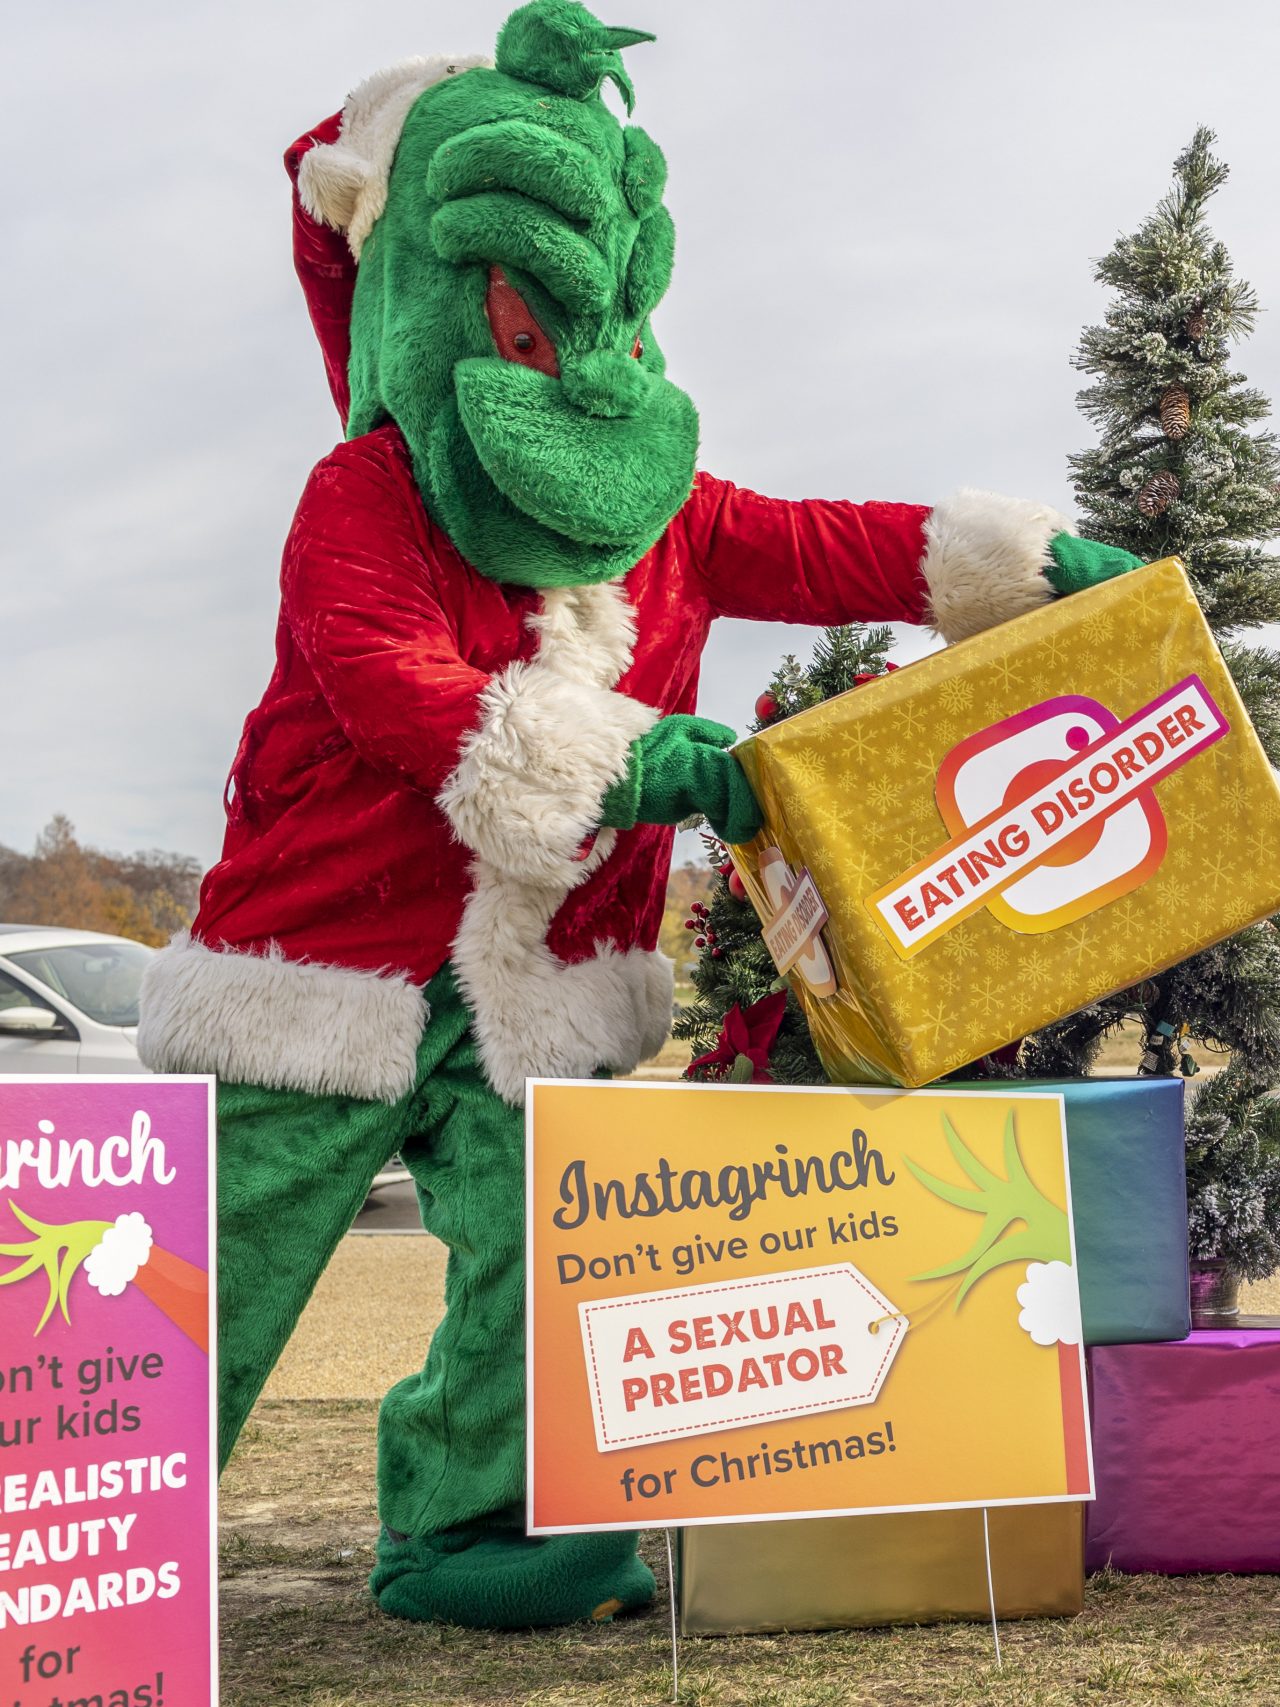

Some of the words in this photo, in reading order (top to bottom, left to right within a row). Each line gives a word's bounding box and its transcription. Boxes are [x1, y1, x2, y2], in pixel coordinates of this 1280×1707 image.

[894, 824, 1030, 931] EATING
[1032, 705, 1204, 834] DISORDER
[0, 1110, 176, 1190] rinch
[553, 1129, 895, 1229] Instagrinch
[557, 1244, 661, 1284] Don't
[673, 1235, 747, 1274] give
[760, 1227, 816, 1254] our
[828, 1211, 898, 1244] kids
[624, 1328, 654, 1362] A
[669, 1300, 834, 1353] SEXUAL
[0, 1355, 62, 1392] n't
[78, 1347, 163, 1394] give
[624, 1345, 845, 1411] PREDATOR
[58, 1399, 140, 1439] kids
[0, 1453, 186, 1514] EALISTIC
[621, 1469, 676, 1501] for
[691, 1422, 895, 1487] Christmas!
[21, 1646, 80, 1682] for
